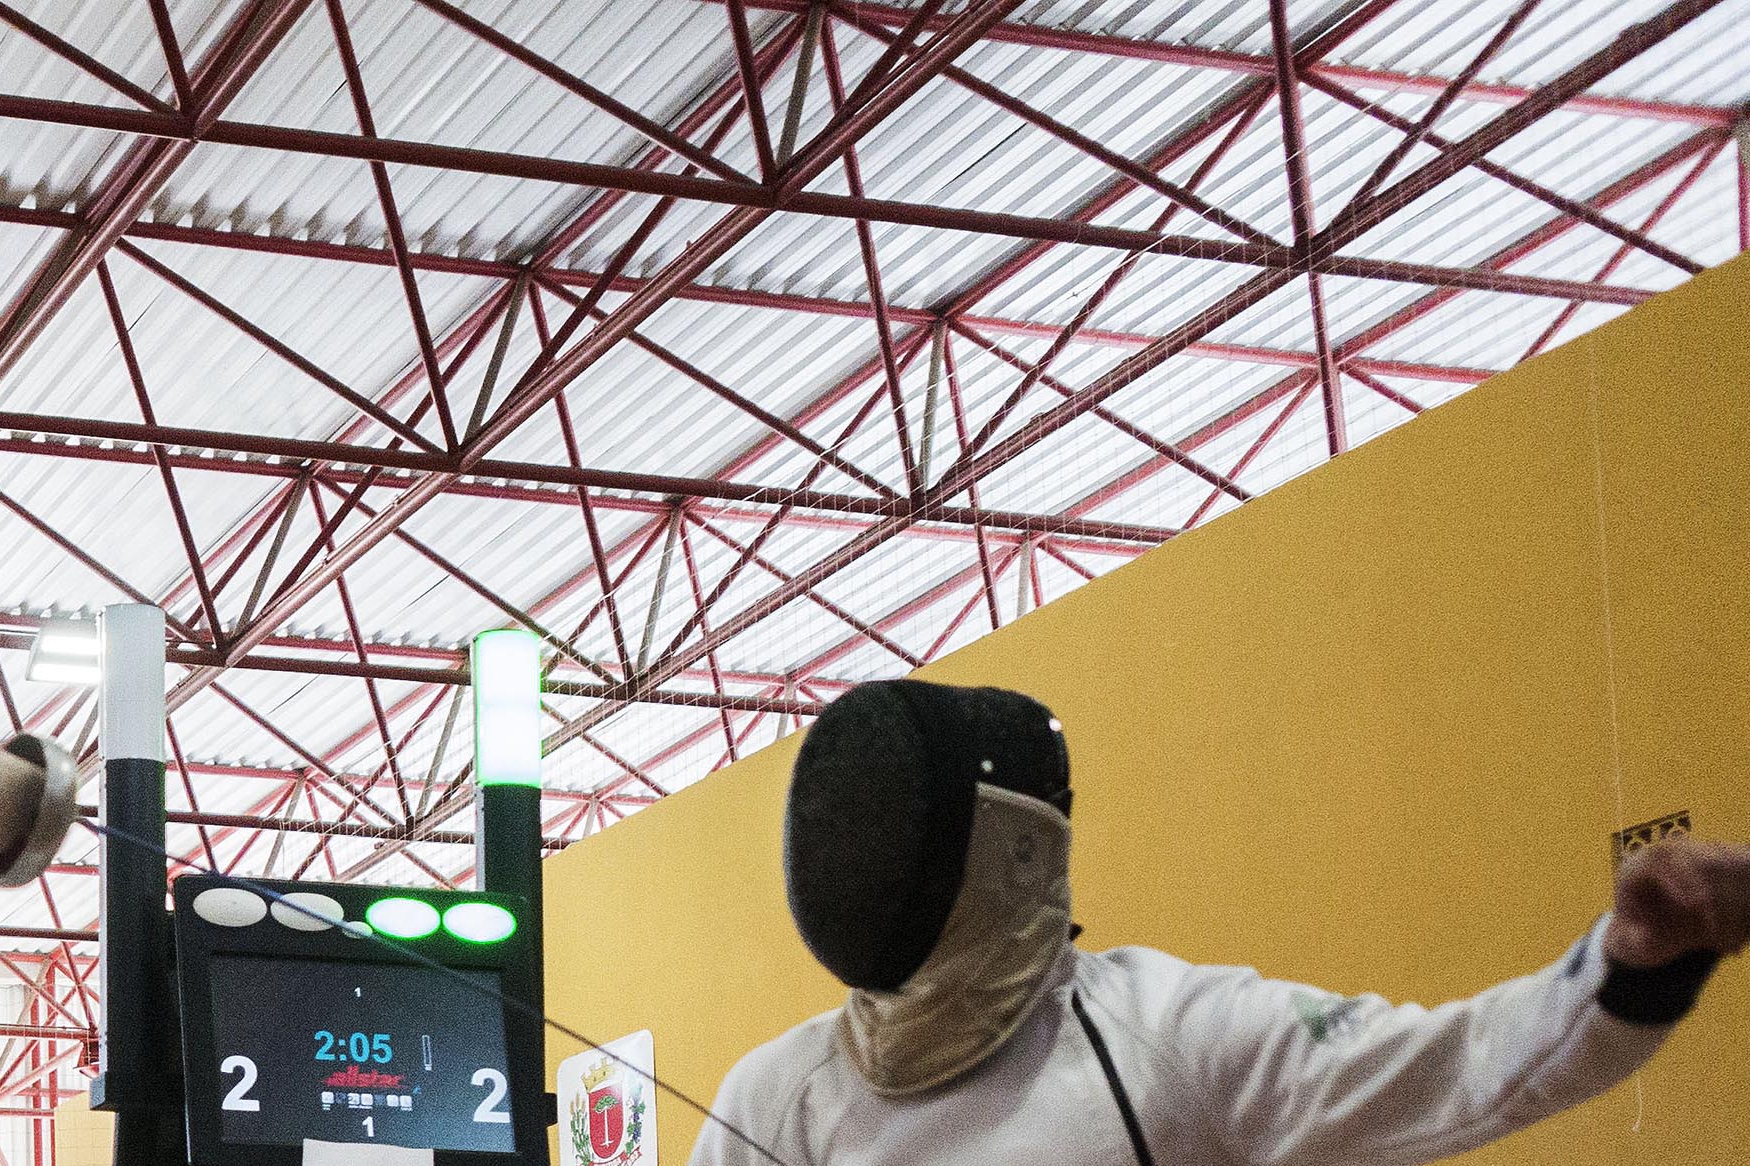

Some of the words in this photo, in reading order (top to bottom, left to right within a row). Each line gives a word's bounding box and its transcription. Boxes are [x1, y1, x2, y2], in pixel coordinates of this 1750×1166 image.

[354, 987, 361, 997] 1
[314, 1030, 393, 1063] 2:05
[220, 1055, 260, 1112] 2
[470, 1067, 510, 1124] 2
[362, 1116, 374, 1137] 1
